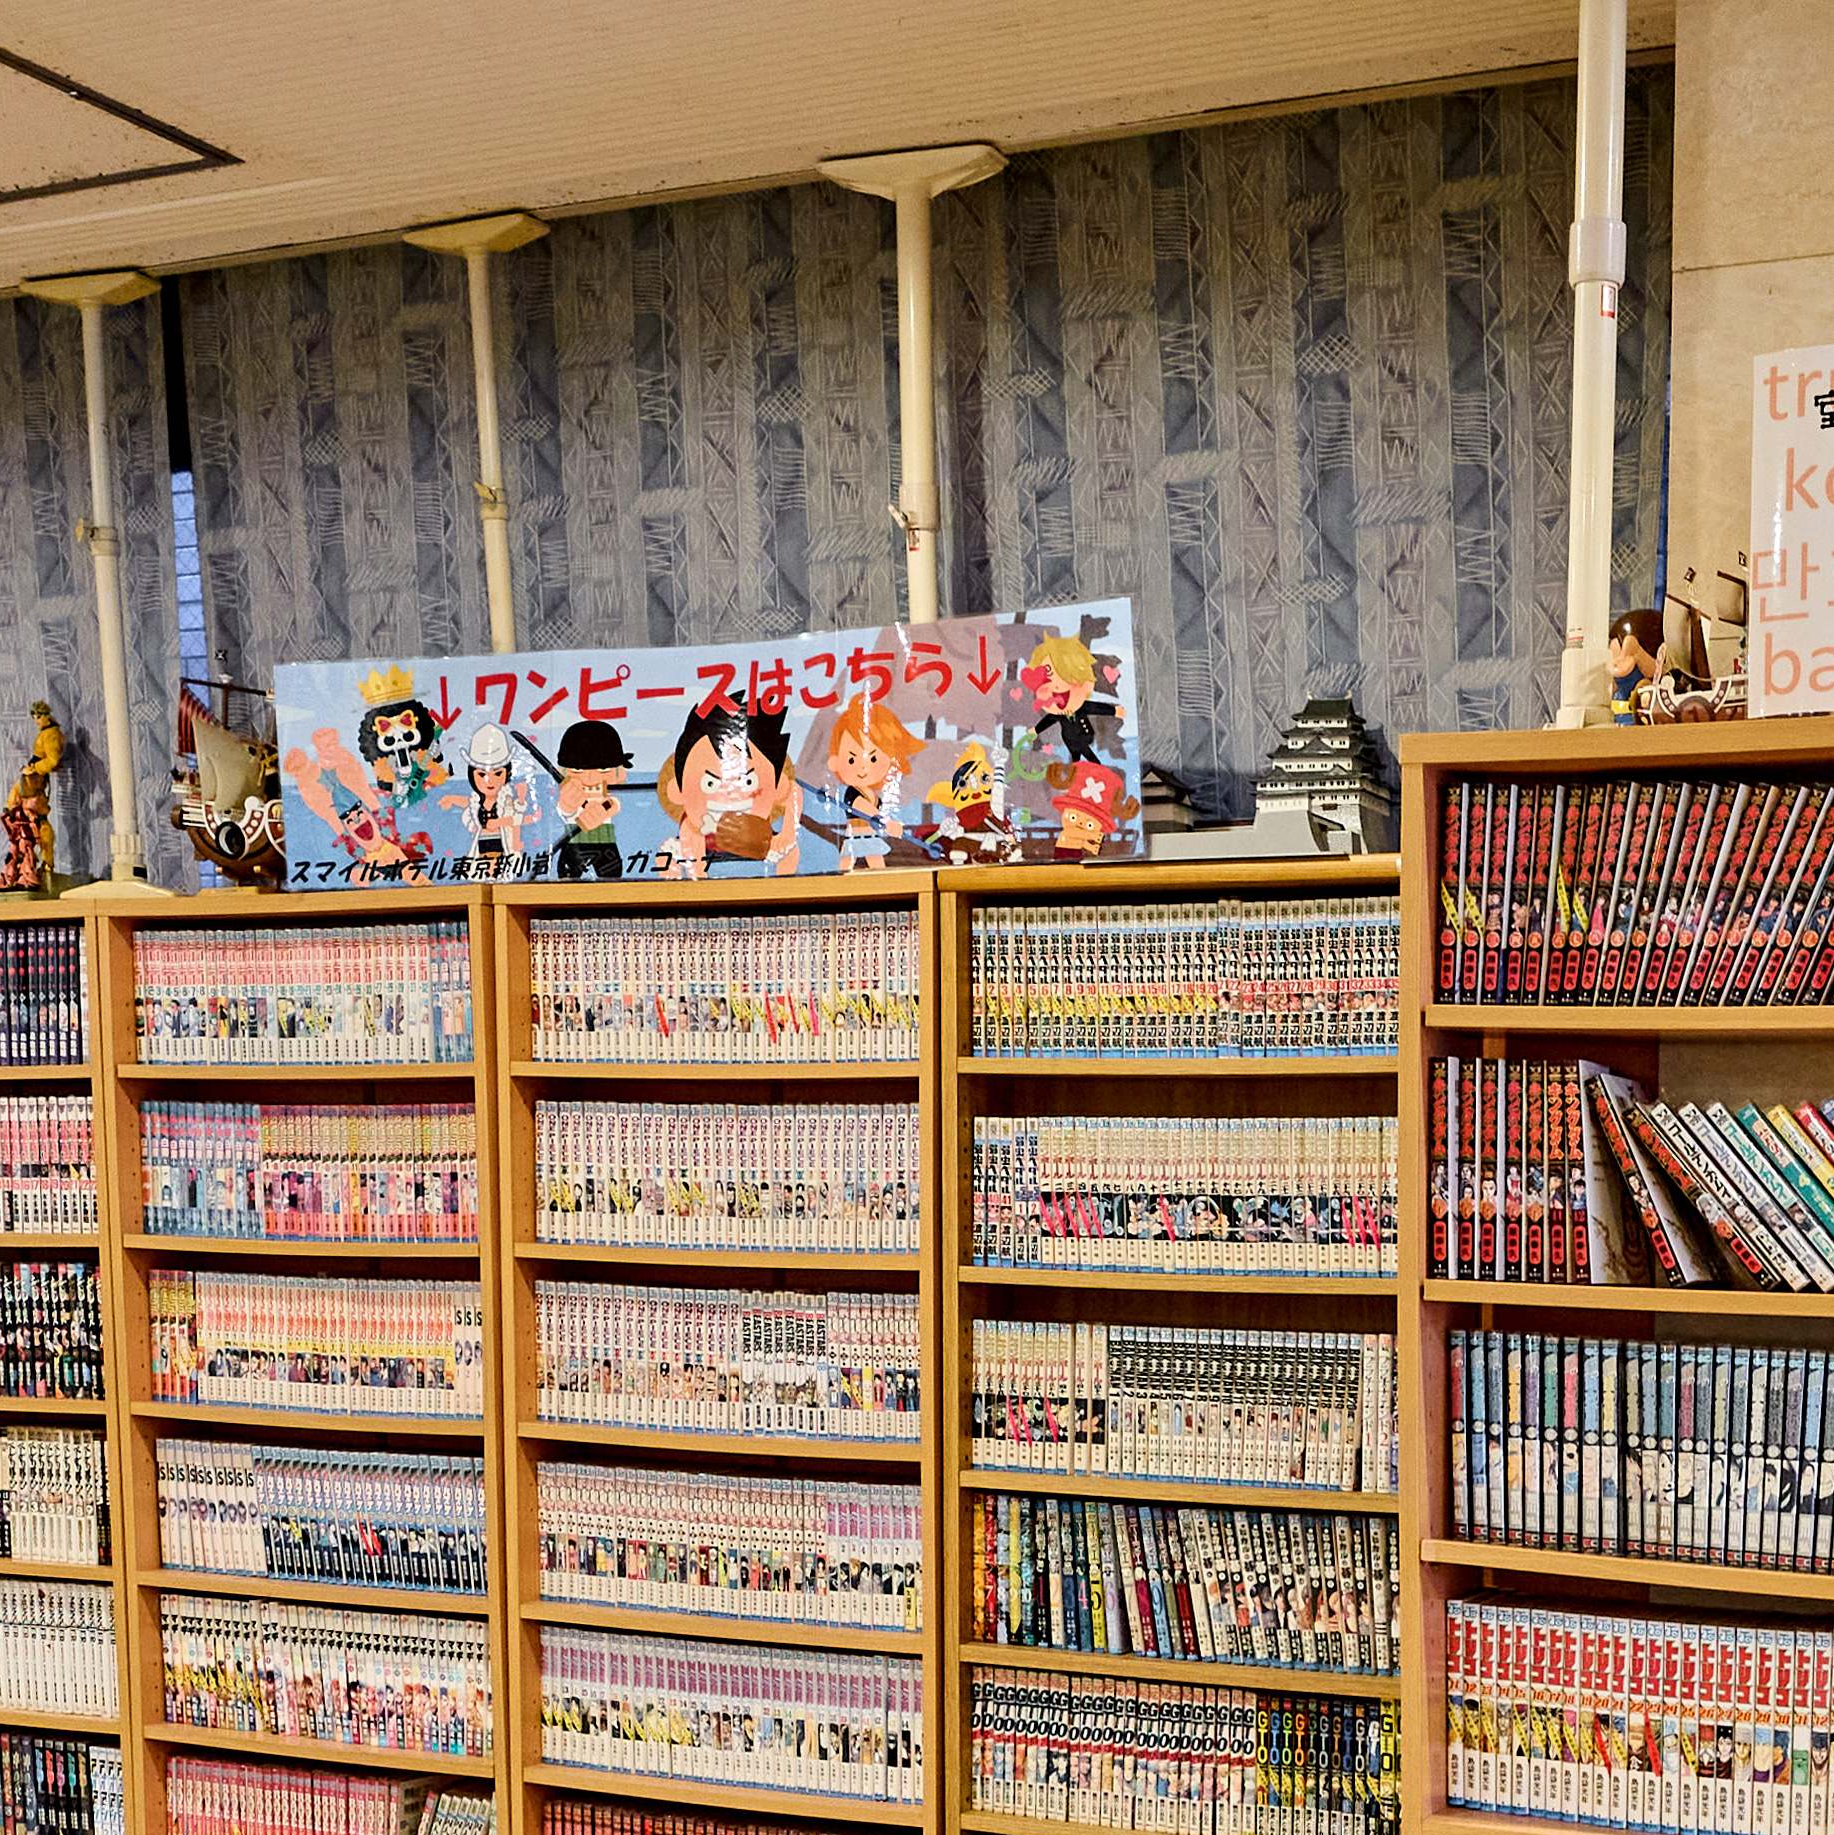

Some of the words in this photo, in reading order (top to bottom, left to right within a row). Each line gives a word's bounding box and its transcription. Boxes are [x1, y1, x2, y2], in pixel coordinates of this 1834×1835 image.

[475, 641, 954, 727] ワンピースはこちら
[1735, 1646, 1752, 1706] トリコ
[1256, 1711, 1268, 1765] GTO
[1294, 1713, 1306, 1767] GTO
[1355, 1718, 1365, 1772] GTO
